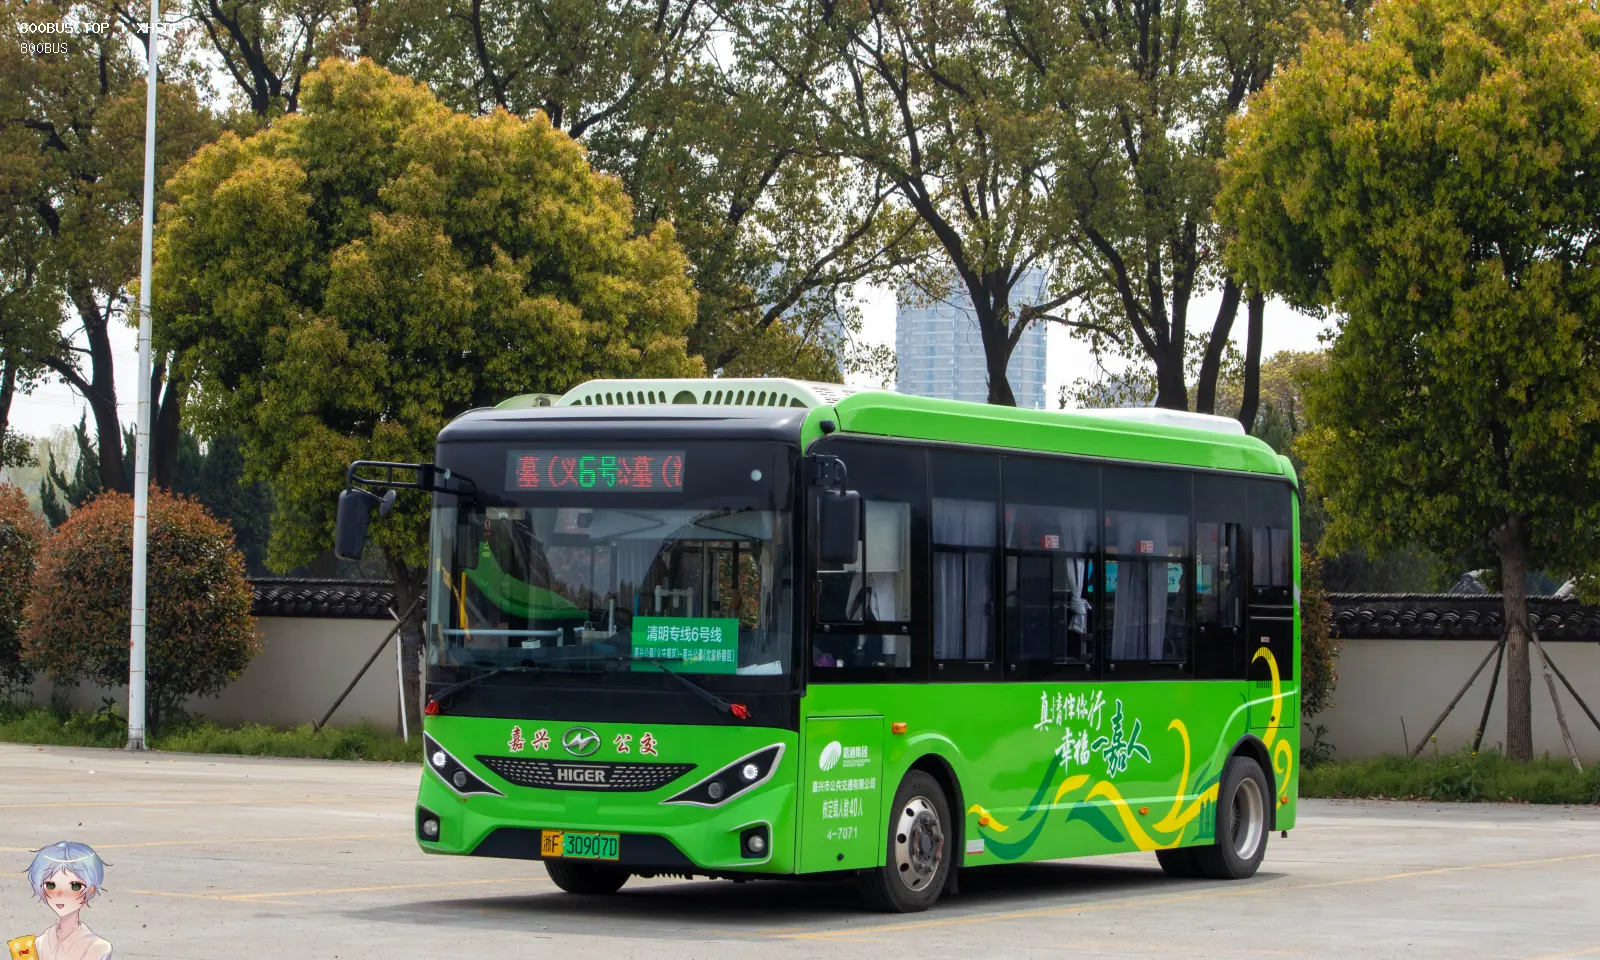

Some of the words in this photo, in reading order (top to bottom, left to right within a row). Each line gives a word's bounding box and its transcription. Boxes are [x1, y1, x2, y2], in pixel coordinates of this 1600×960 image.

[647, 625, 722, 643] 清明专线6号线
[557, 768, 606, 783] HIGER
[812, 778, 876, 793] 嘉兴市公共交通有限公司
[827, 827, 858, 840] 4-7071
